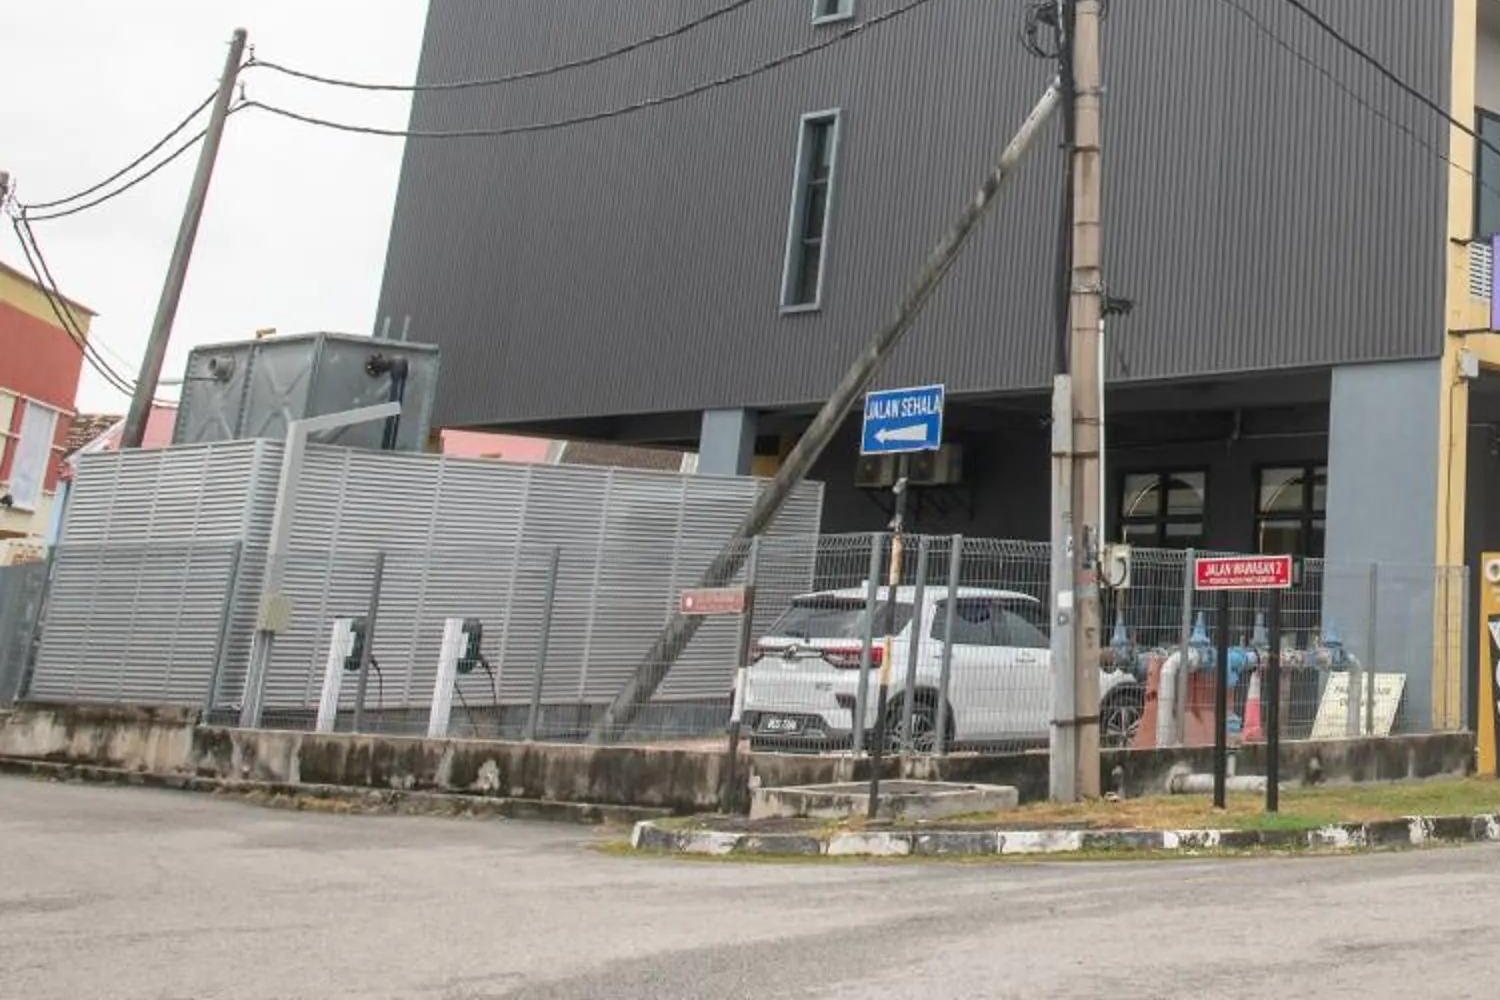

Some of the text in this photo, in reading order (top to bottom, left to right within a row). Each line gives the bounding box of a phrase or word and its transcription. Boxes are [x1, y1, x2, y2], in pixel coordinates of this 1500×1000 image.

[865, 394, 942, 420] JALAN SEHALA
[1204, 563, 1232, 577] JALAN
